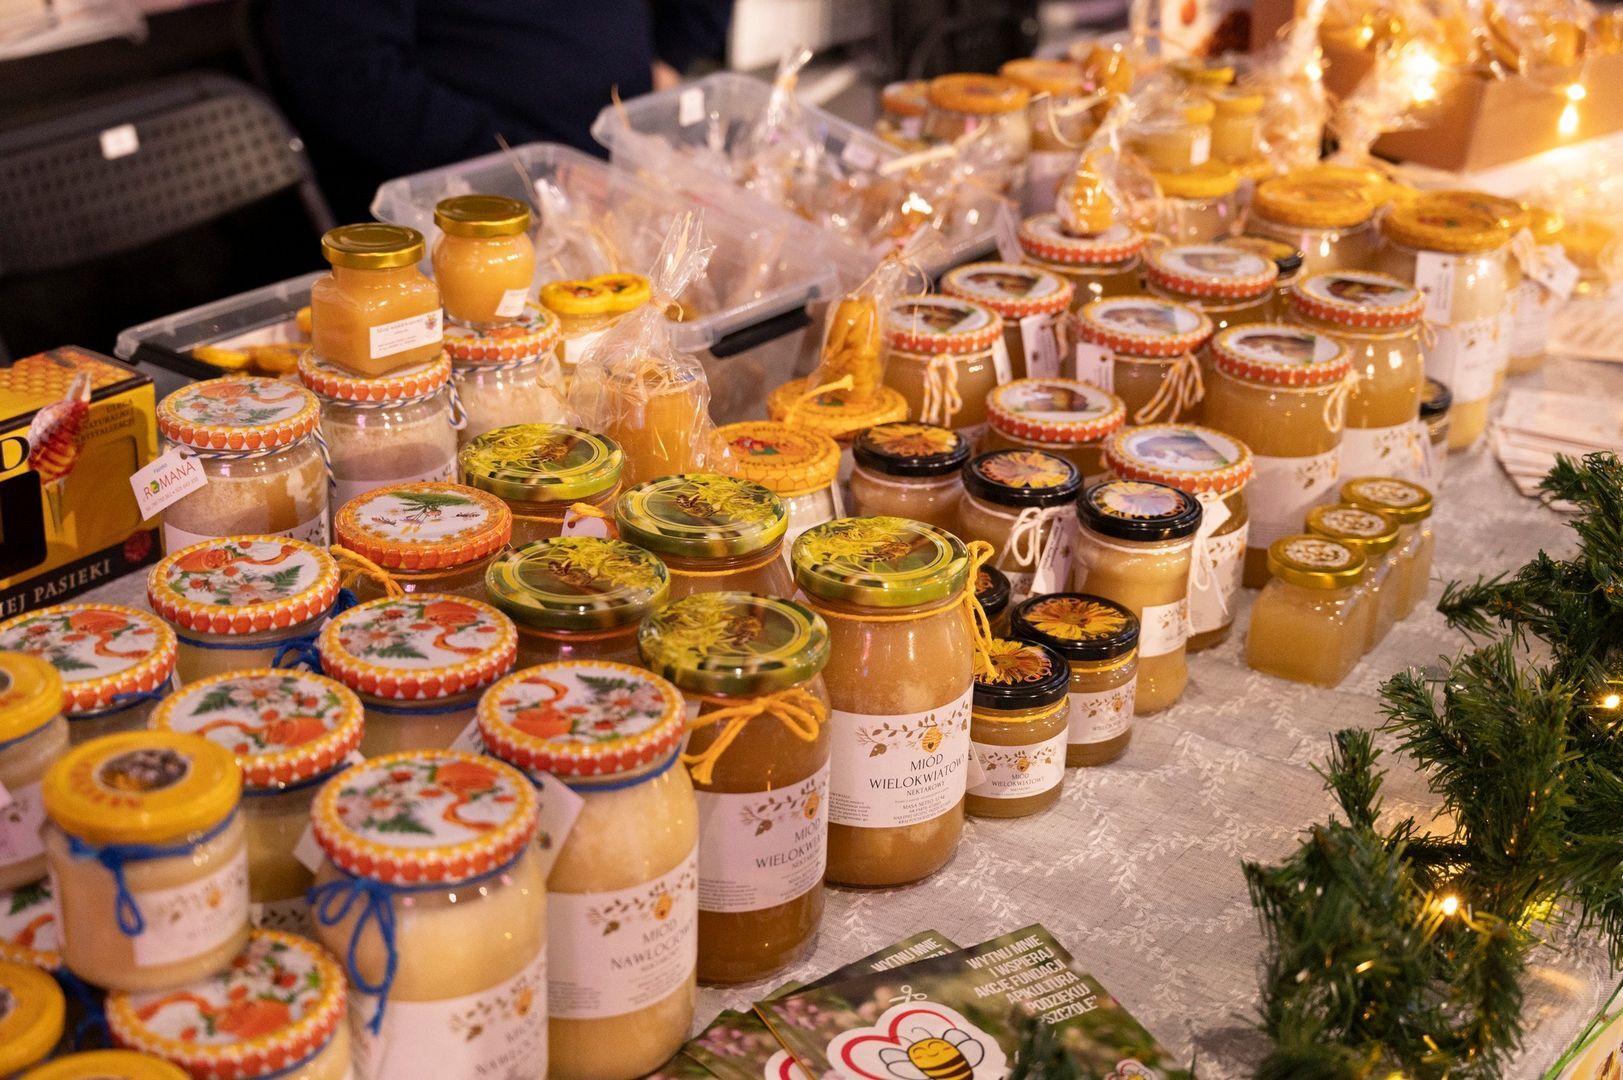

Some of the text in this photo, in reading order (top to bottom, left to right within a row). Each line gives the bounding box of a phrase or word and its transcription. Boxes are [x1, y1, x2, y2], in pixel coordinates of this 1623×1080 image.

[143, 461, 196, 499] ROMANA
[34, 559, 111, 603] PASIEKI
[869, 753, 965, 790] WIELOKWIATOWY
[910, 753, 944, 772] MIÓD
[991, 776, 1045, 788] WIELOKWIATOWY
[908, 937, 943, 957] MNIE
[1009, 934, 1045, 955] MNIE
[988, 946, 1055, 978] I WSPIERAJ
[973, 958, 1068, 999] AKCJĘ FUNDACJI
[1006, 971, 1080, 1004] APIKULTURA
